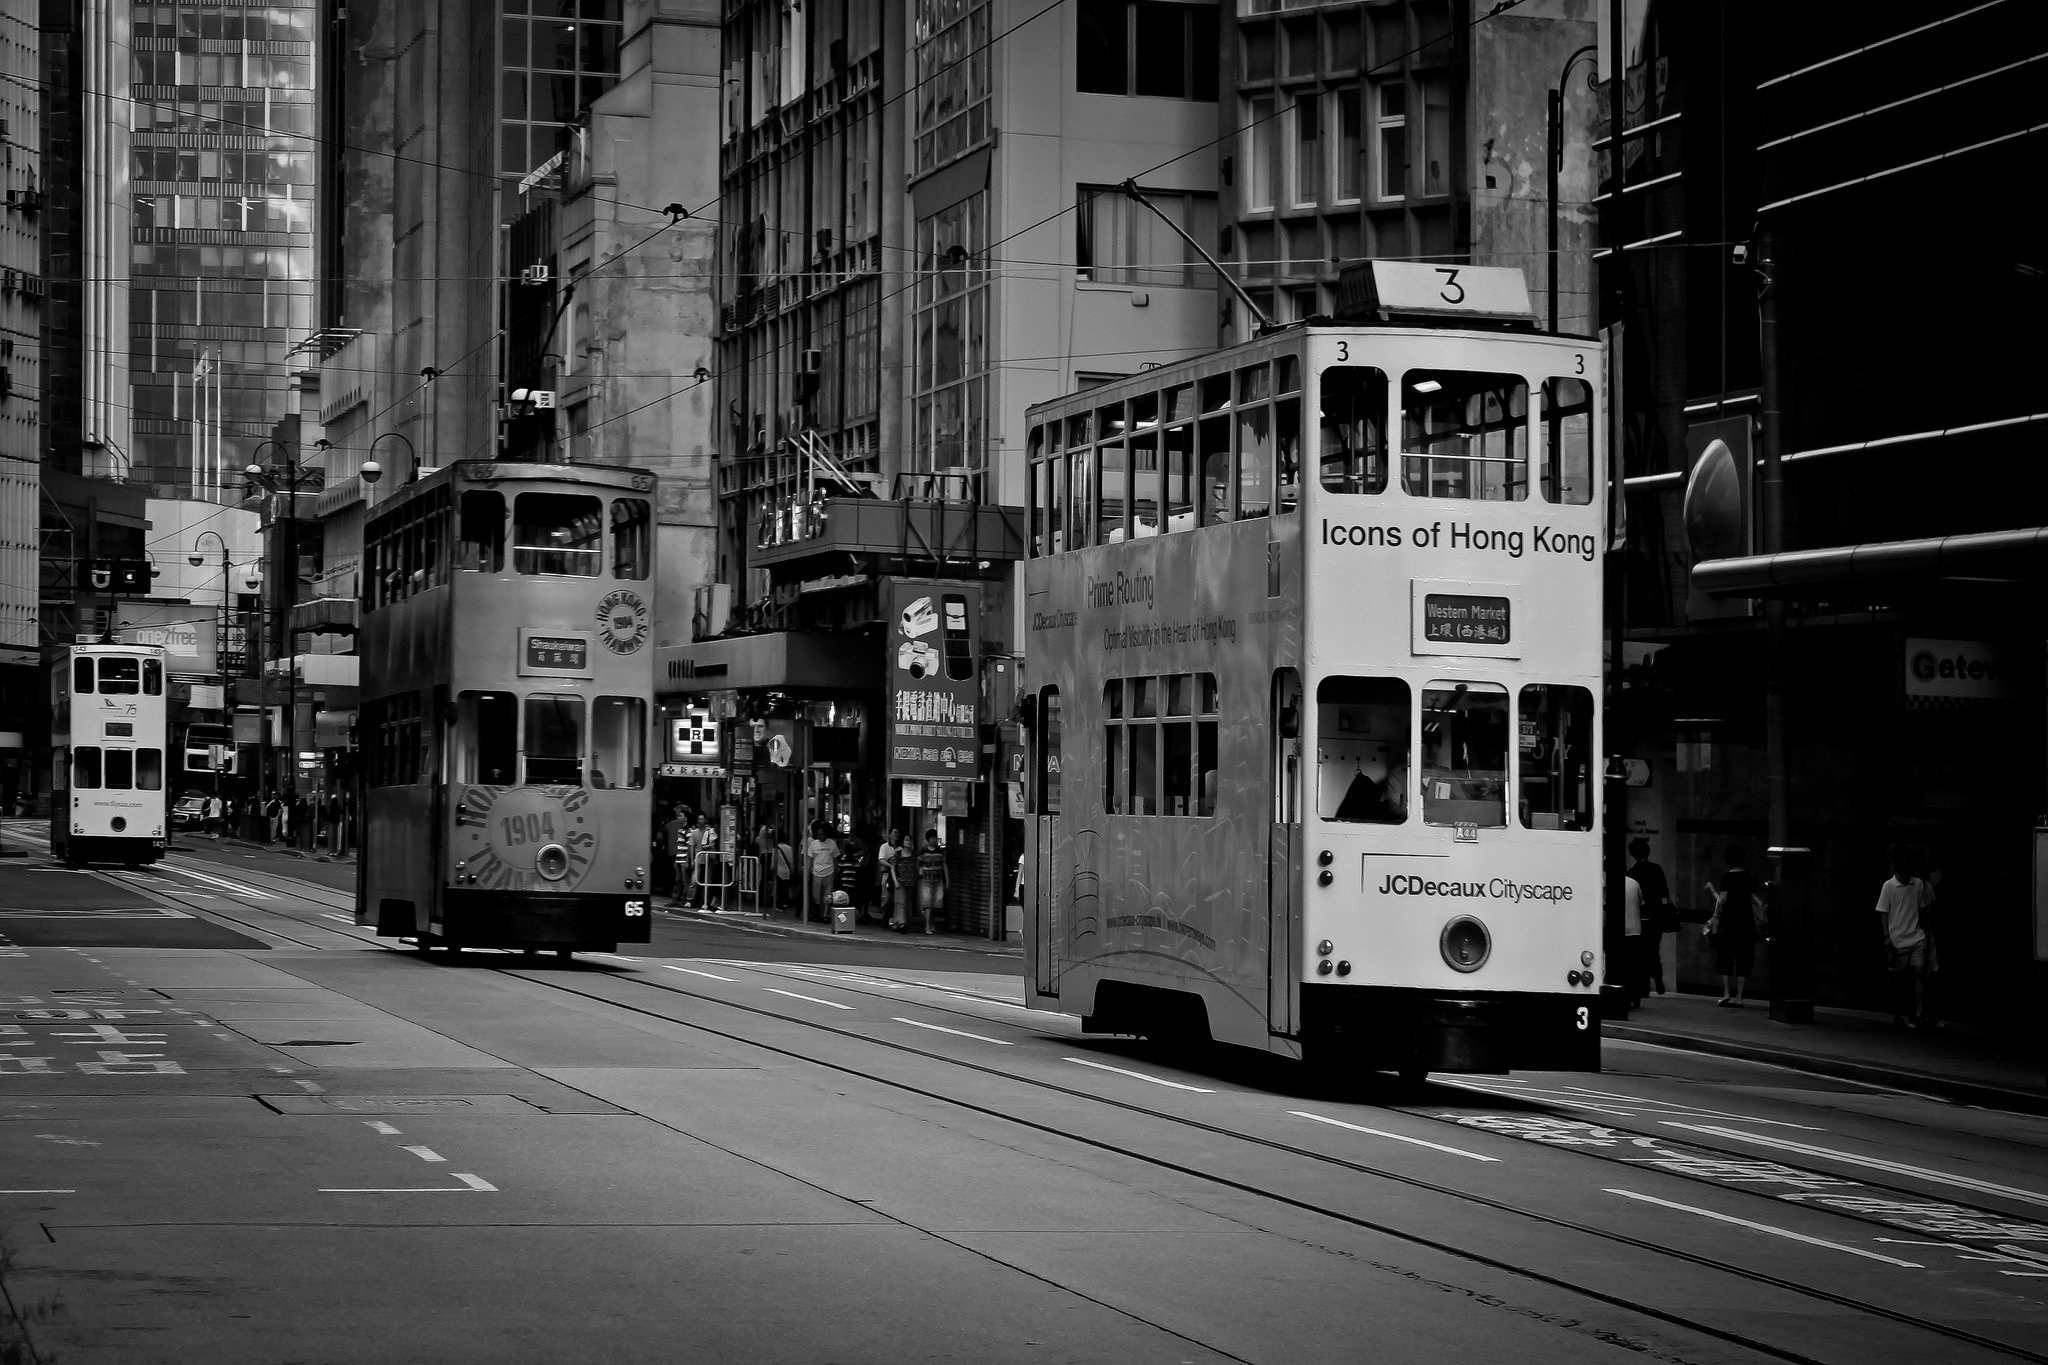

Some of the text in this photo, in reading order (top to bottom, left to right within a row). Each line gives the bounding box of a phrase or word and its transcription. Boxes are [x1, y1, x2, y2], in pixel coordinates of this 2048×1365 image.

[1435, 268, 1466, 304] 3
[1337, 341, 1349, 362] 3
[1575, 354, 1585, 374] 3
[631, 475, 648, 490] 65
[1322, 518, 1596, 561] Icons of Hong Kong
[1088, 569, 1154, 610] Prime Routing
[1427, 603, 1507, 621] Western Market
[136, 629, 198, 646] one2free
[1104, 627, 1127, 655] Optimal
[1129, 624, 1152, 651] Visibility
[1160, 622, 1172, 645] the
[1172, 620, 1191, 645] Heart
[1192, 618, 1201, 643] of
[1201, 616, 1217, 646] Hong
[1217, 615, 1236, 645] Kong
[501, 811, 555, 847] 1904
[1379, 874, 1573, 905] JCDecaux Cityscape
[624, 900, 645, 917] 65
[1575, 1006, 1590, 1031] 3
